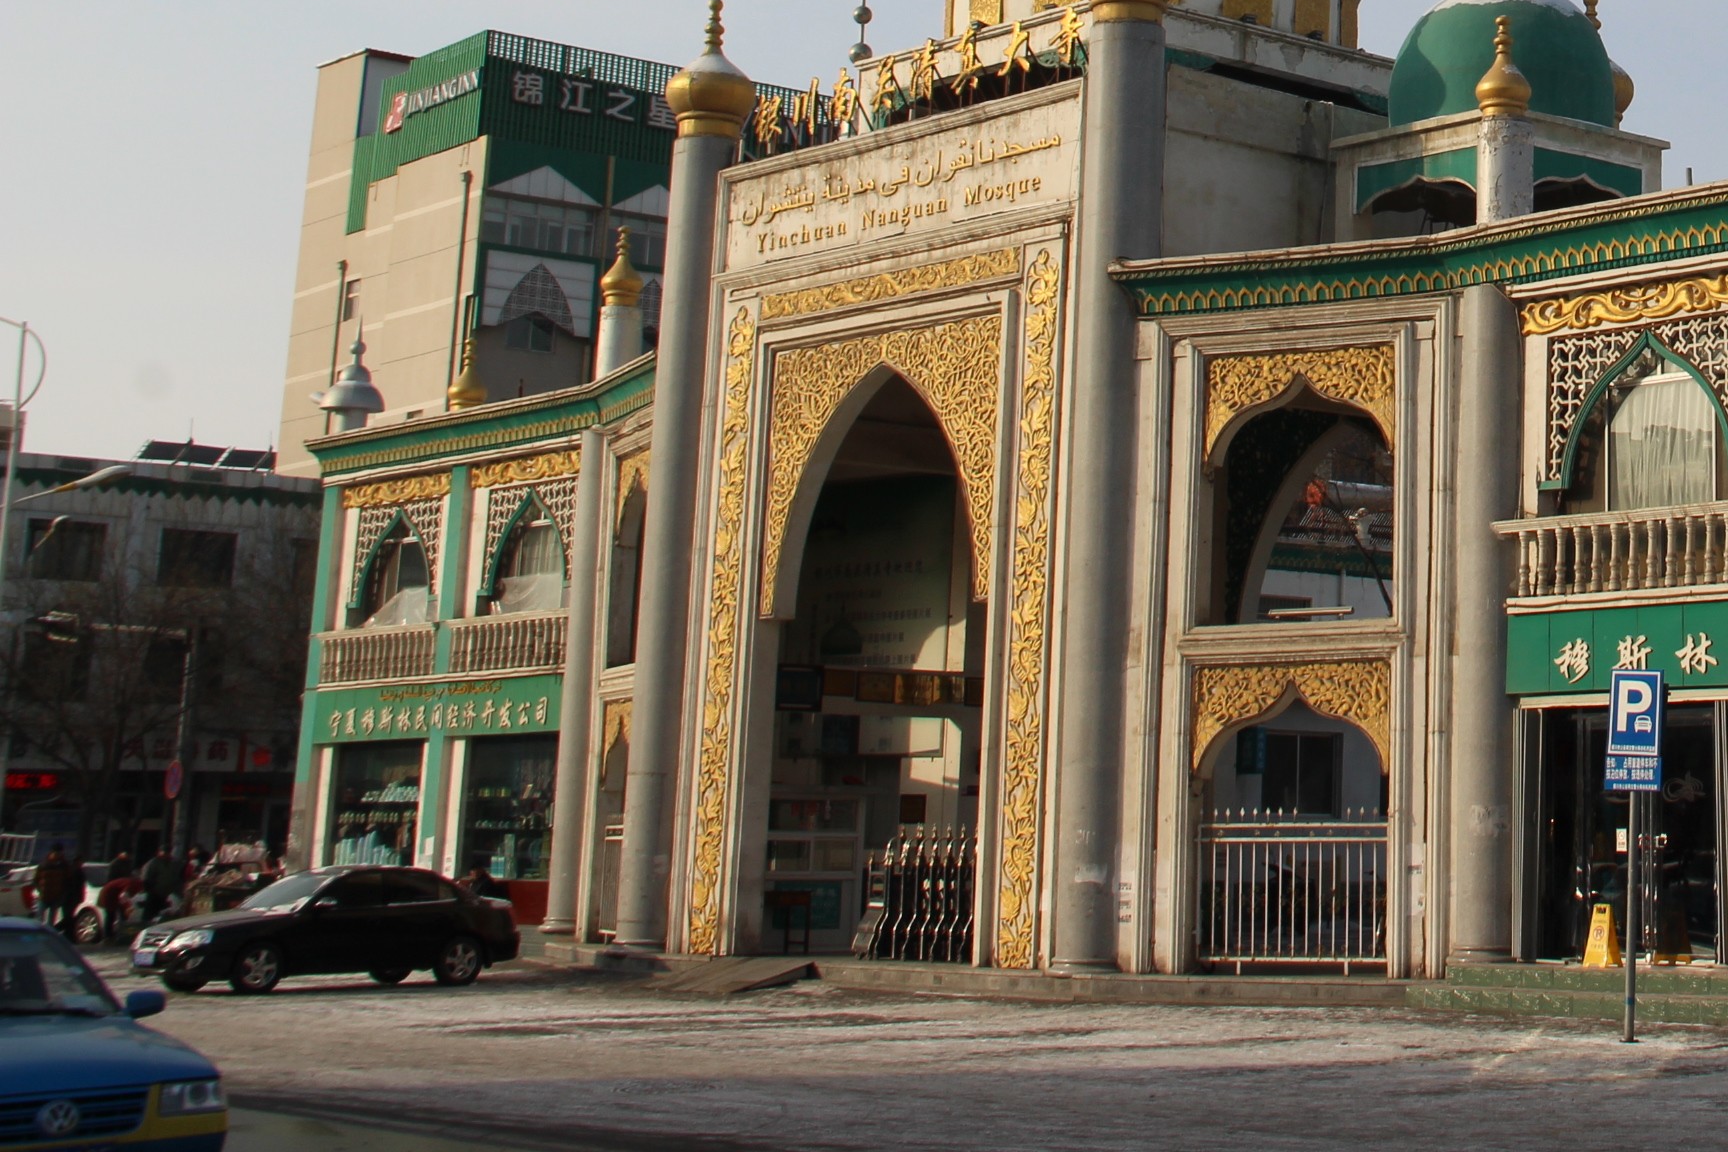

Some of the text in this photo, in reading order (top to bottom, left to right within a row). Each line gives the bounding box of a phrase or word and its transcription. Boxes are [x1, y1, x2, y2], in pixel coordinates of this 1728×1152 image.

[512, 70, 677, 130] 锦江之星
[757, 174, 1041, 253] Yinchuan Nanguan Mosque
[1617, 680, 1652, 732] P
